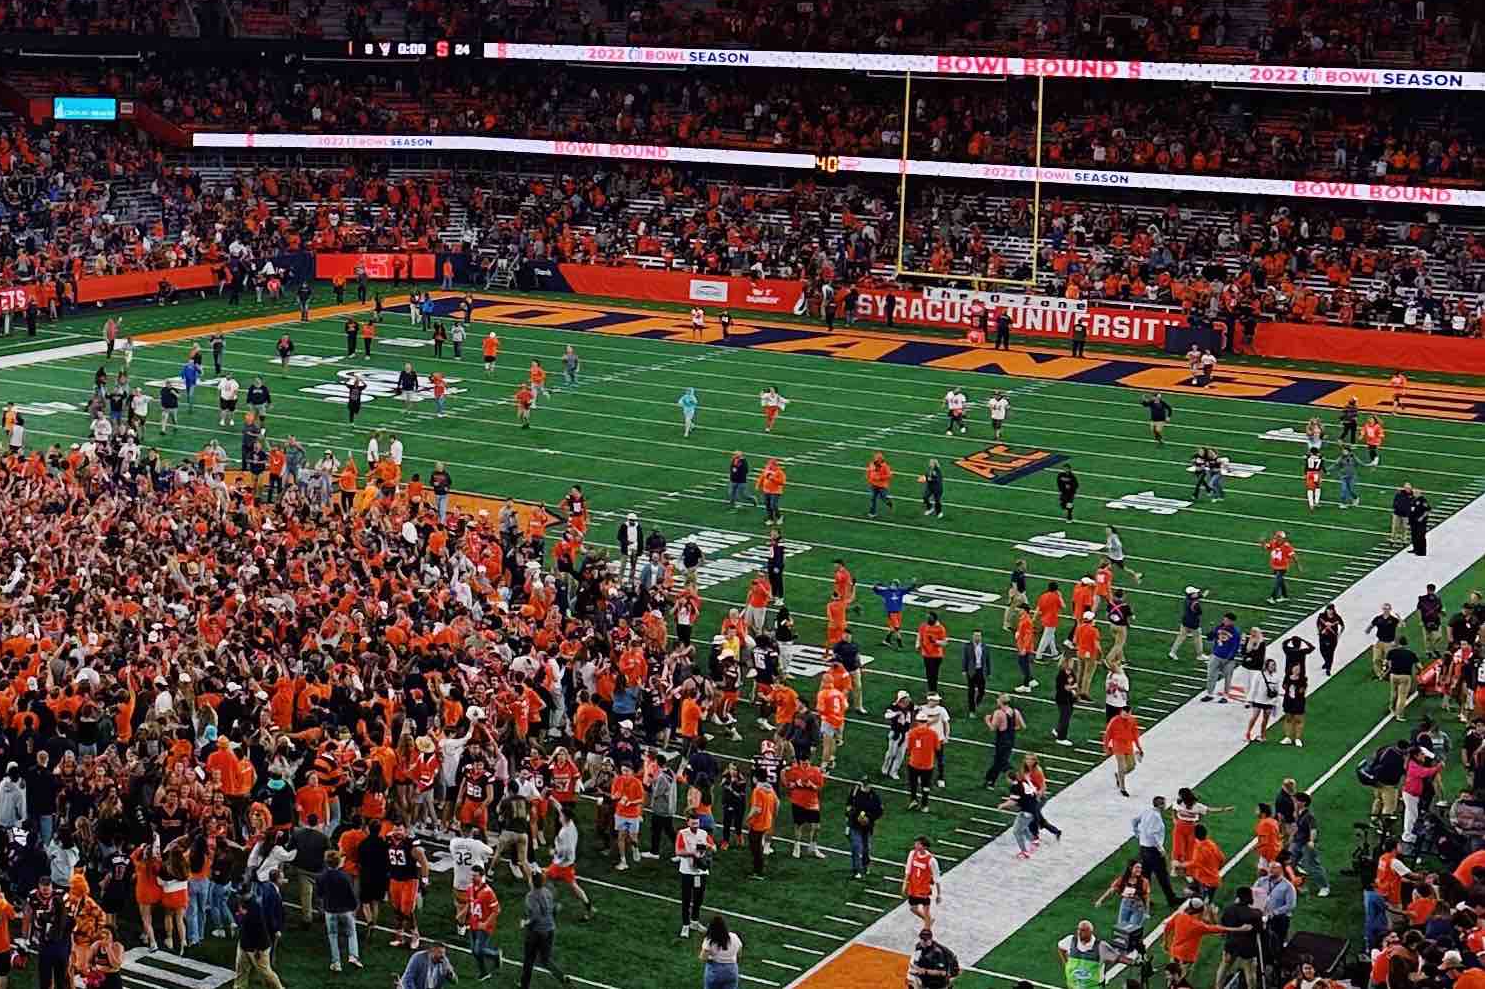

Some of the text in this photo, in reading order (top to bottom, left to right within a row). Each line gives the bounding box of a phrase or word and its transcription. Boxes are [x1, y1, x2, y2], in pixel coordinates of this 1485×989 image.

[587, 48, 750, 64] 2022 BOWL SEASON
[937, 55, 1009, 74] BOWL
[1024, 58, 1119, 77] BOUND
[1249, 68, 1464, 88] 2022 BOWL SEASON
[390, 138, 433, 148] SEASON
[554, 142, 670, 159] BOWL BOUND
[816, 156, 838, 172] 40
[1074, 172, 1129, 184] SEASON
[1294, 182, 1452, 202] BOWL BOUND
[455, 850, 473, 867] 32
